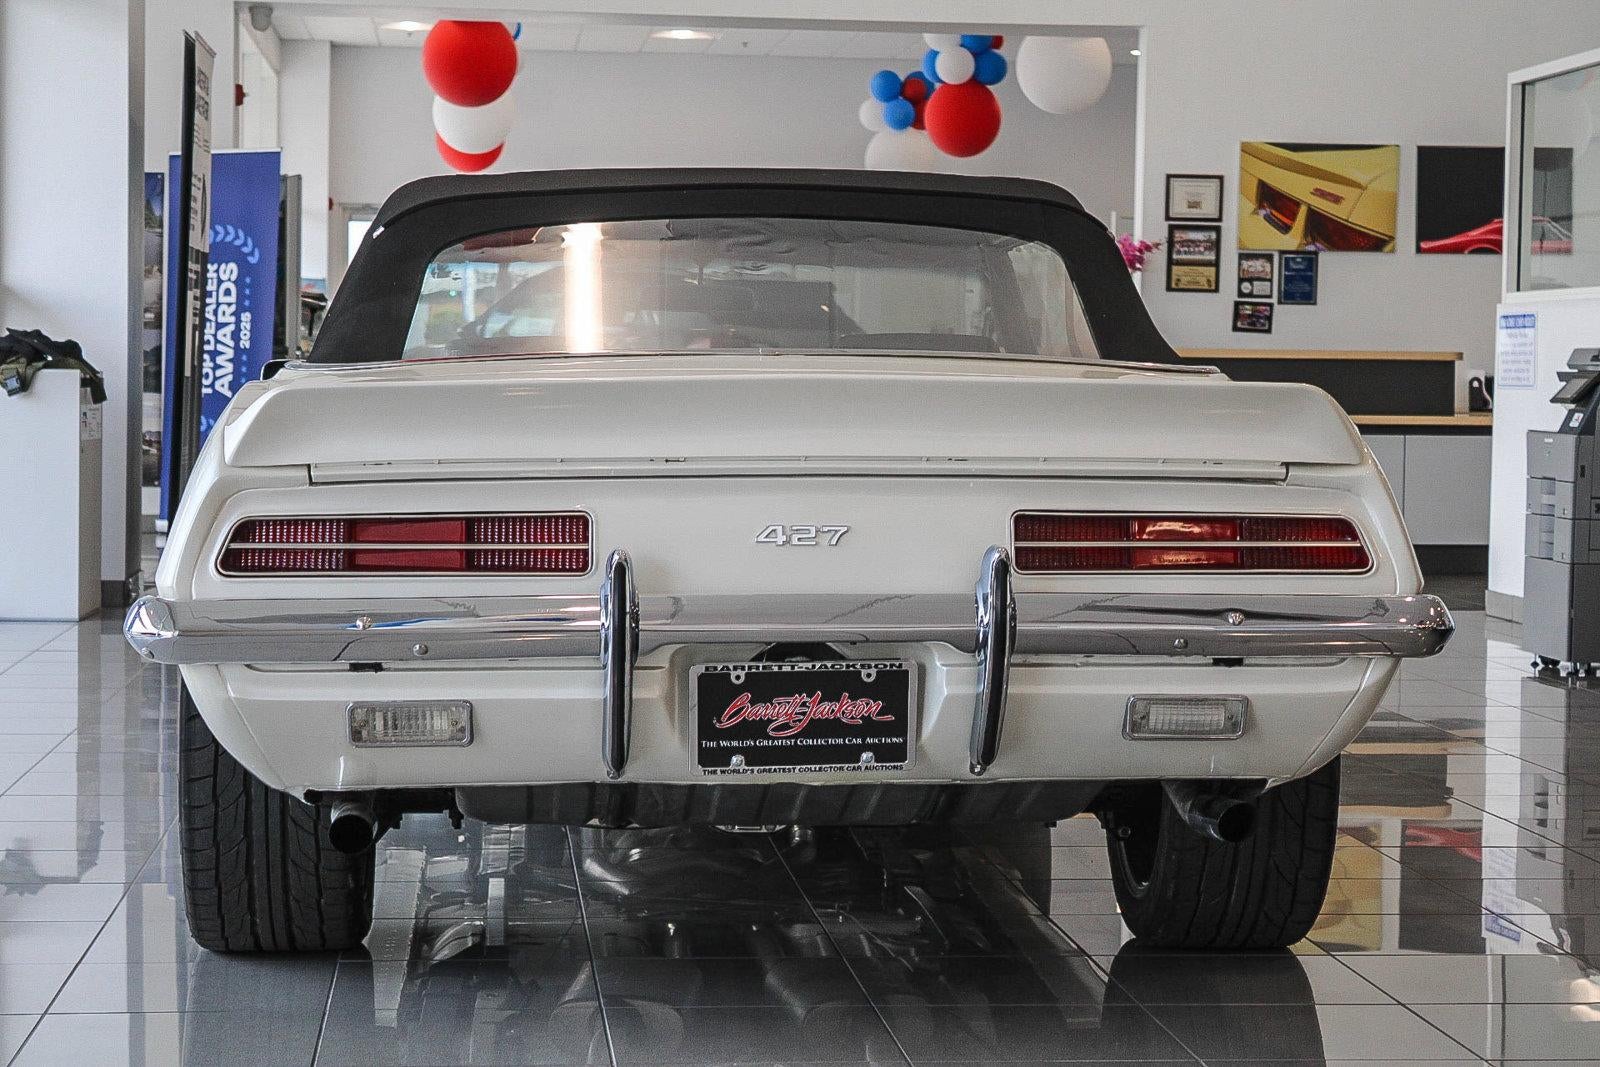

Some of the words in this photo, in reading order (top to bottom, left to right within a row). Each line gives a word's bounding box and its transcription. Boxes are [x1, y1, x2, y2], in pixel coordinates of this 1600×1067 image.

[203, 262, 218, 351] DEALER
[214, 261, 239, 398] AWARDS
[240, 311, 252, 349] 2025
[202, 353, 214, 397] TOP
[754, 524, 850, 546] 427
[704, 662, 903, 672] BARRETT-JACKSON
[701, 740, 717, 748] THE
[756, 738, 795, 747] GREATEST
[797, 737, 844, 746] COLLECTOR
[845, 737, 862, 745] CAR
[865, 736, 904, 744] AUCTIONS
[798, 765, 844, 773] COLLECTOR
